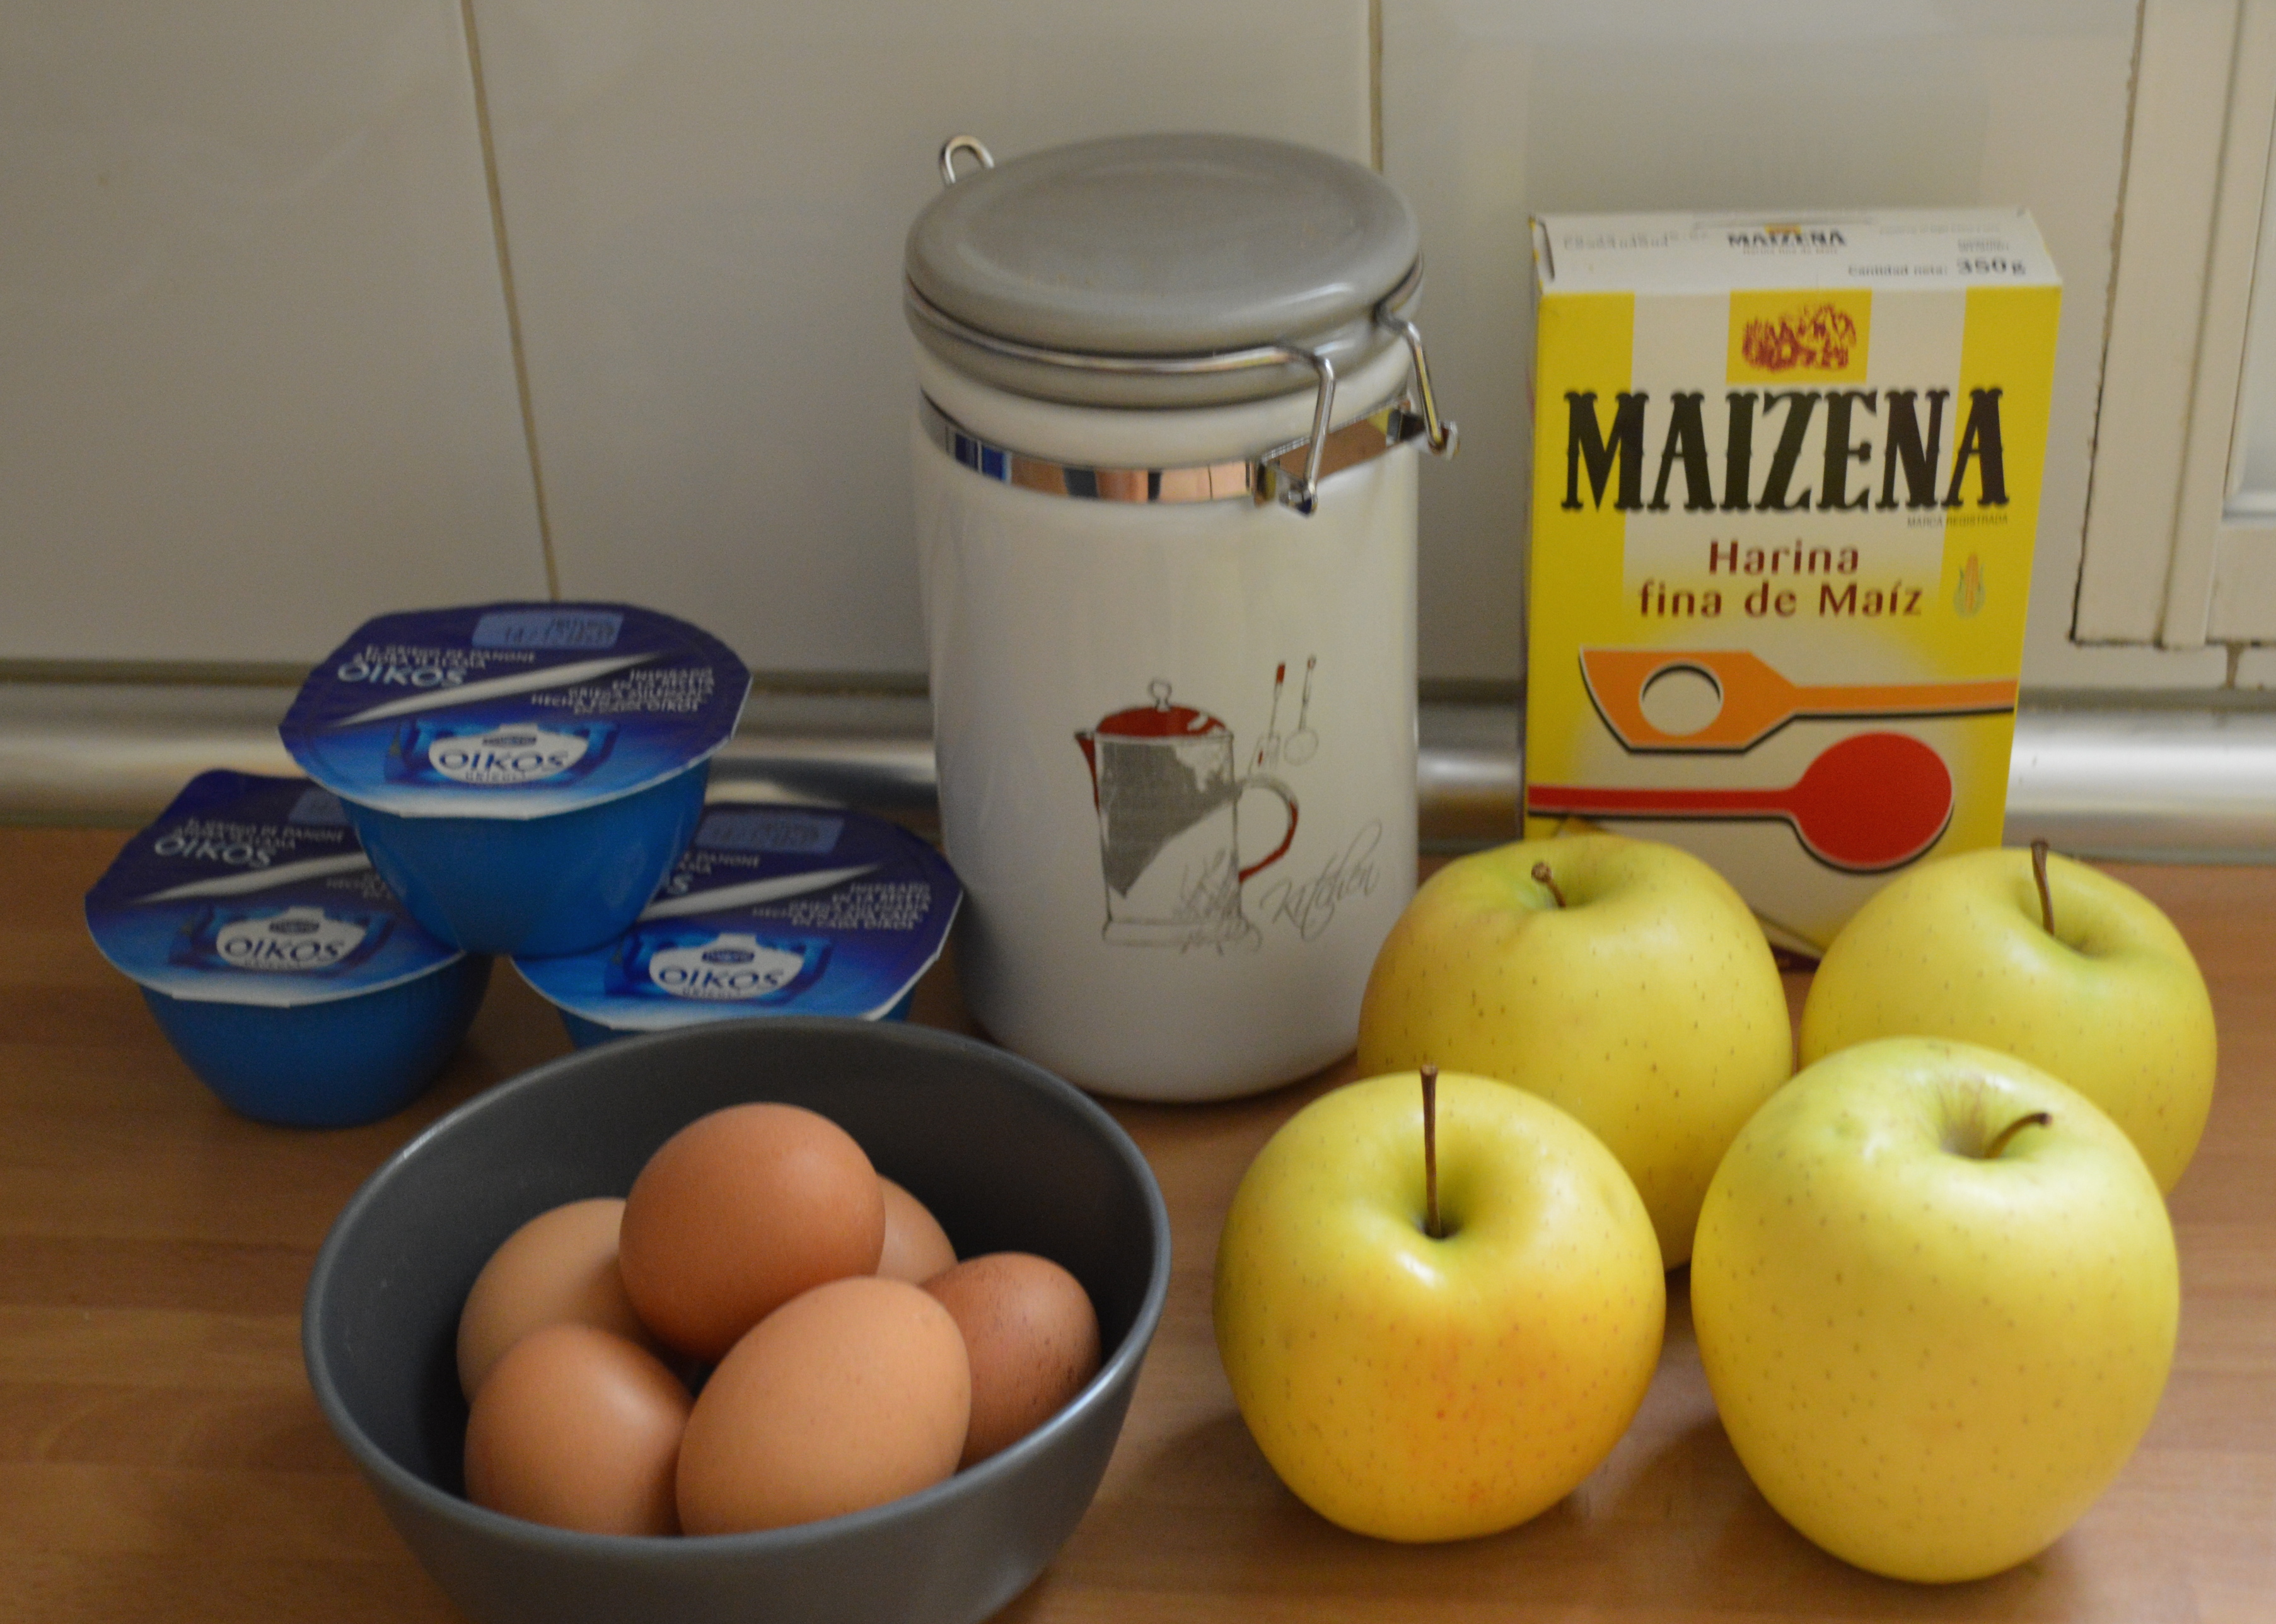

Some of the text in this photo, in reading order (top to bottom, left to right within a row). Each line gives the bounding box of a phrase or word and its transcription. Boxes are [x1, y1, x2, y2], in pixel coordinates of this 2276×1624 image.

[1727, 228, 1846, 247] MAIZENA
[1561, 387, 2009, 513] MAIZENA
[1907, 514, 2008, 529] MARCA REGISTRADA
[1709, 537, 1859, 576] Harina
[1639, 577, 1922, 618] fina de Maíz
[337, 662, 468, 688] OIKOS
[439, 748, 569, 772] OIKOS
[154, 835, 277, 868] OIKOS
[224, 936, 344, 960] OIKOS
[659, 965, 783, 988] OIKOS
